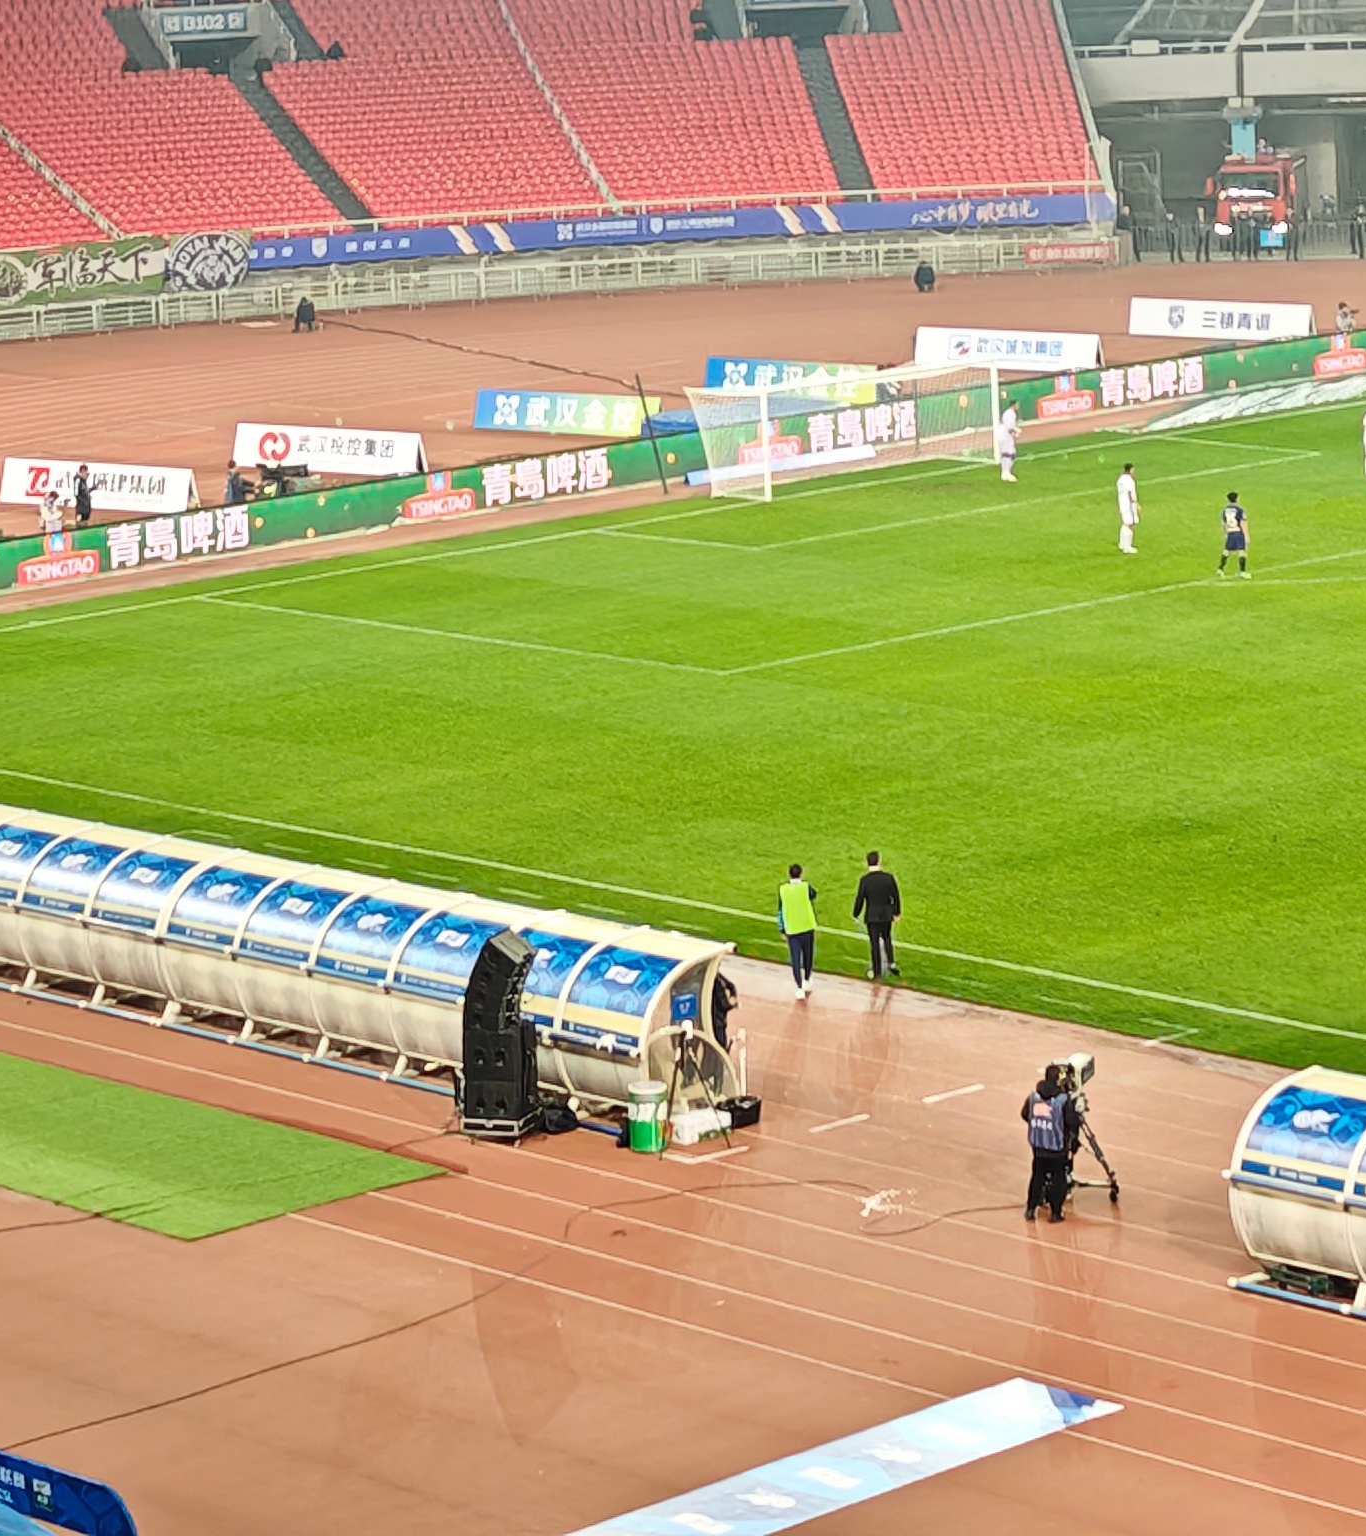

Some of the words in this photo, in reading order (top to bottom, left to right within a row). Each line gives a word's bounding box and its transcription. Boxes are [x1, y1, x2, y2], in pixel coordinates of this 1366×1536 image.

[524, 395, 638, 432] 武汉金控
[406, 491, 474, 519] TSINGTAO
[22, 553, 96, 583] TSINGTAO
